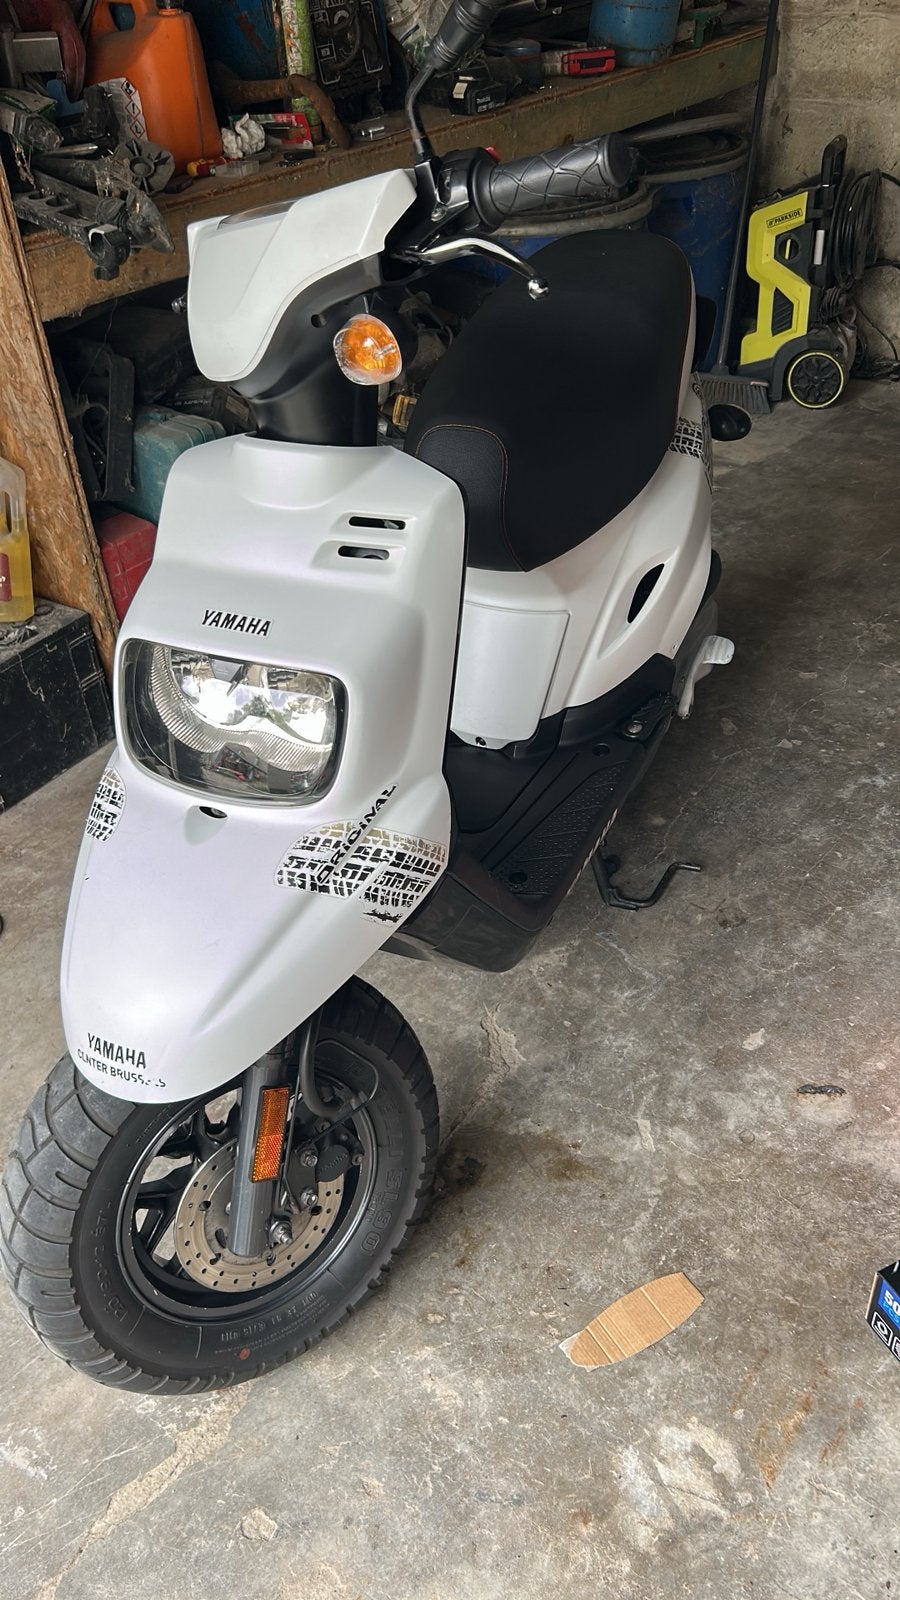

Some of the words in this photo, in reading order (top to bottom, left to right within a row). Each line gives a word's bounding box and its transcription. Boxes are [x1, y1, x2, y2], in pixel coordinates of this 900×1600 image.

[773, 210, 801, 224] PARKSIDE
[201, 609, 271, 637] YAMAHA
[87, 1032, 147, 1070] YAMAHA
[110, 1066, 167, 1088] BRUSSS
